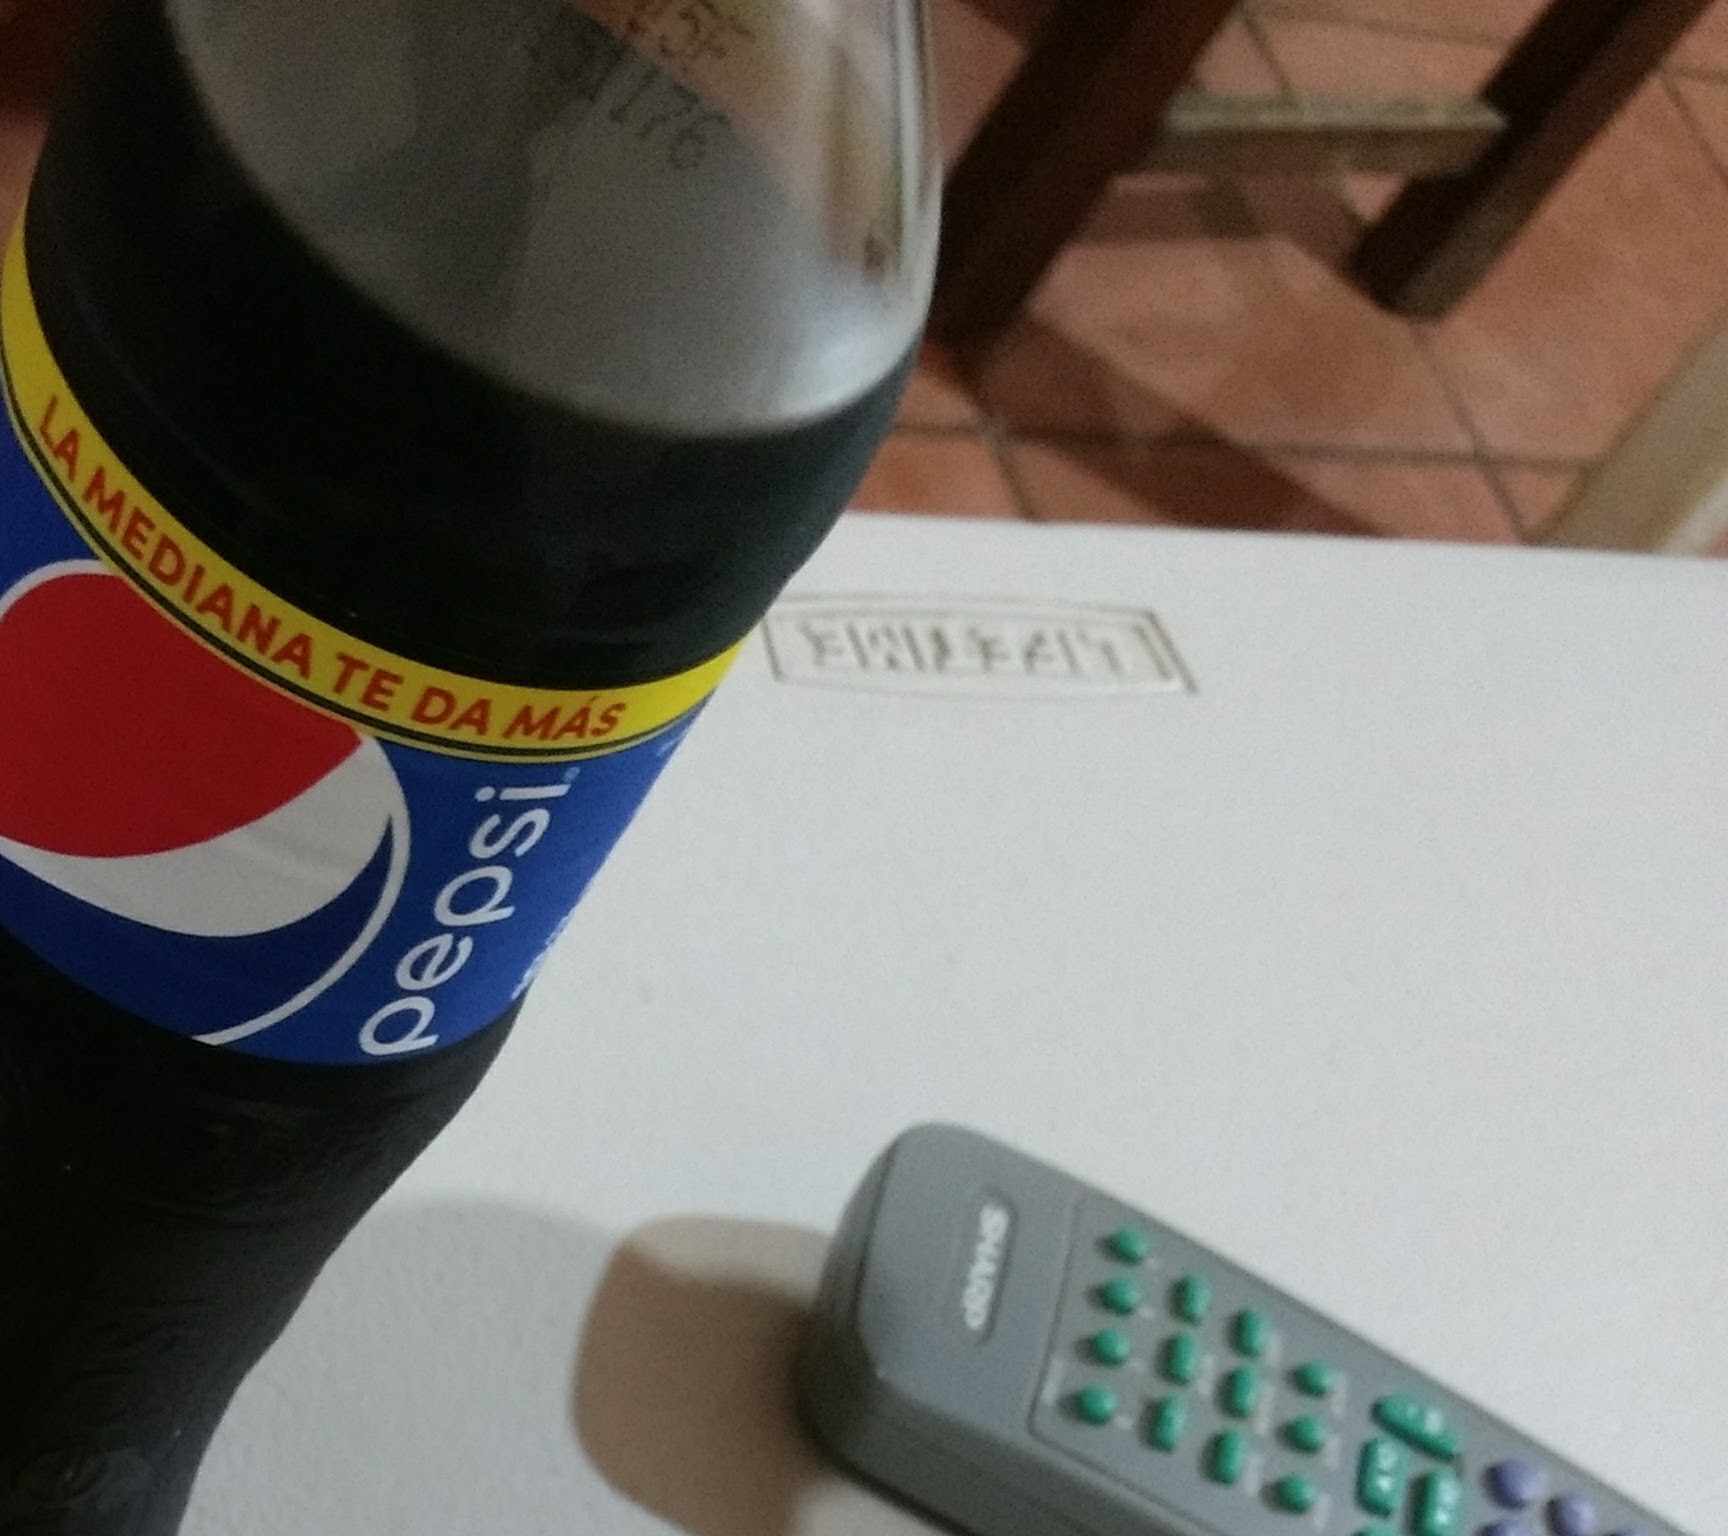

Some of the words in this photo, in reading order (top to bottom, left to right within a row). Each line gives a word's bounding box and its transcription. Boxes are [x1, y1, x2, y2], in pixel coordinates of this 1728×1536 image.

[39, 396, 80, 483] LA
[83, 466, 313, 680] MEDIANA
[333, 652, 403, 711] TE
[410, 686, 492, 736] DA
[502, 695, 627, 741] MÁS
[359, 784, 571, 1056] pepsi
